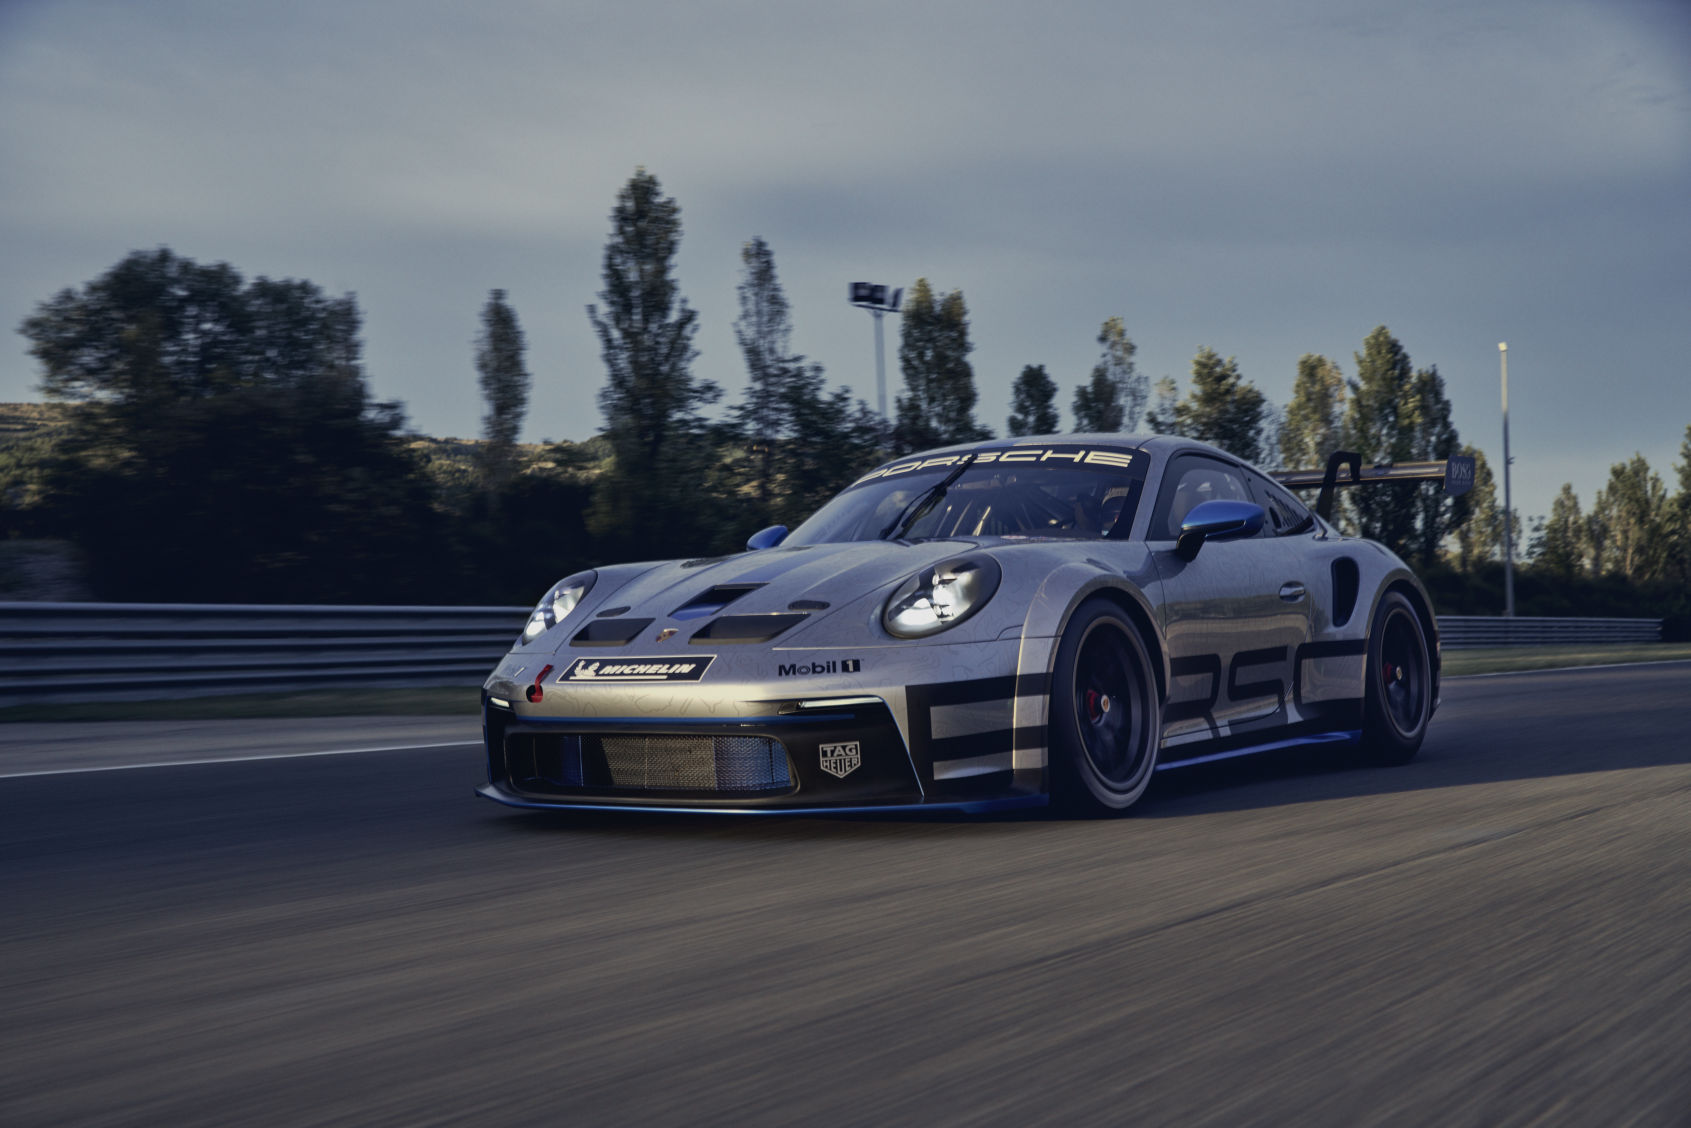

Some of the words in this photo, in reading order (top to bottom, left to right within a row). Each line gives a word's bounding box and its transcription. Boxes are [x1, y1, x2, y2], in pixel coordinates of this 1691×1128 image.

[850, 450, 1133, 488] PORSCHE
[599, 664, 697, 675] MICHELIN
[778, 661, 837, 677] Mobil
[823, 745, 857, 758] TAG
[823, 758, 858, 775] HEUER
